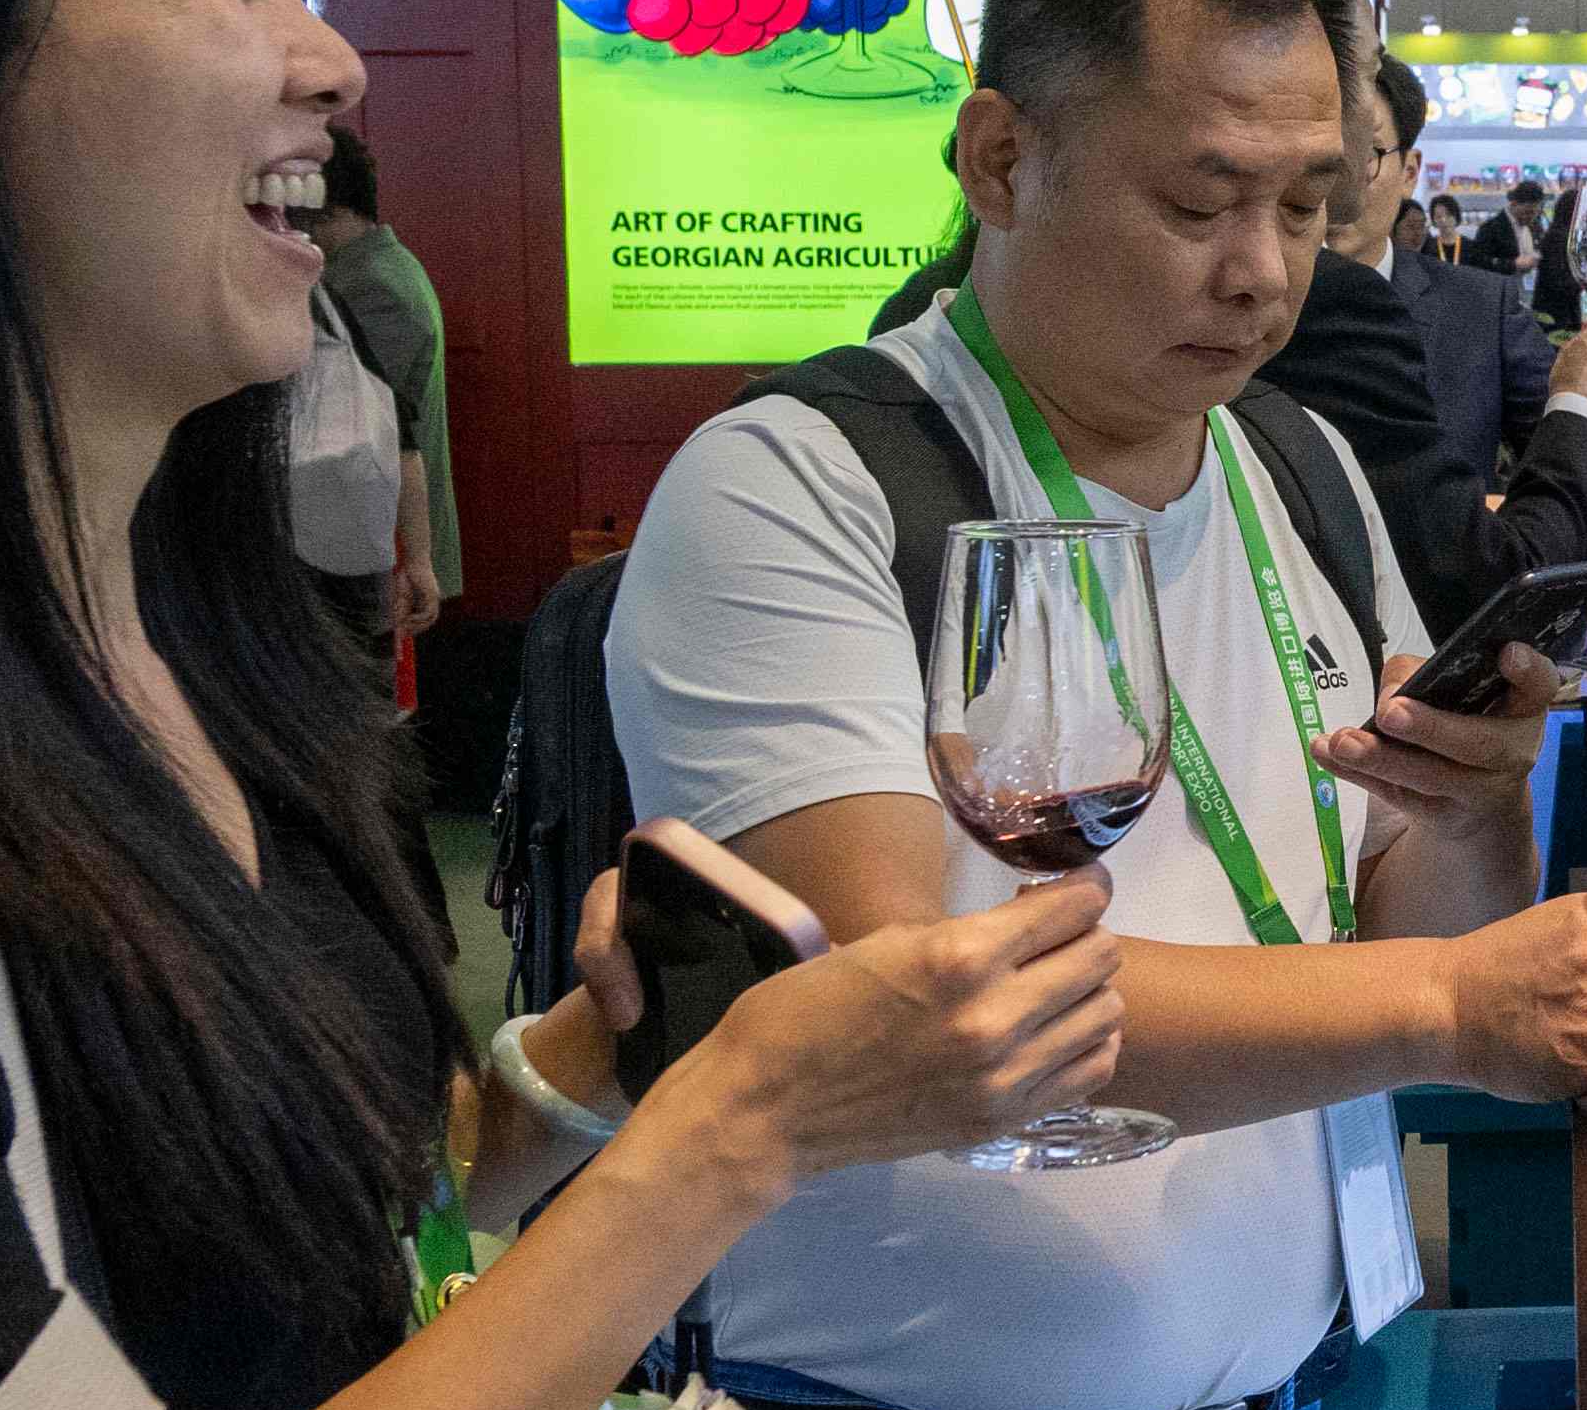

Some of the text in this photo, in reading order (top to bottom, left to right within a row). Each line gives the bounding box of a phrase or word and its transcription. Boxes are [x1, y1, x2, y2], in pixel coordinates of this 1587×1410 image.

[611, 210, 863, 234] ART OF CRAFTING
[612, 246, 764, 268] GEORGIAN
[1313, 668, 1349, 691] idas
[1176, 723, 1240, 841] INTERNATIONAL
[1186, 771, 1213, 814] EXPO
